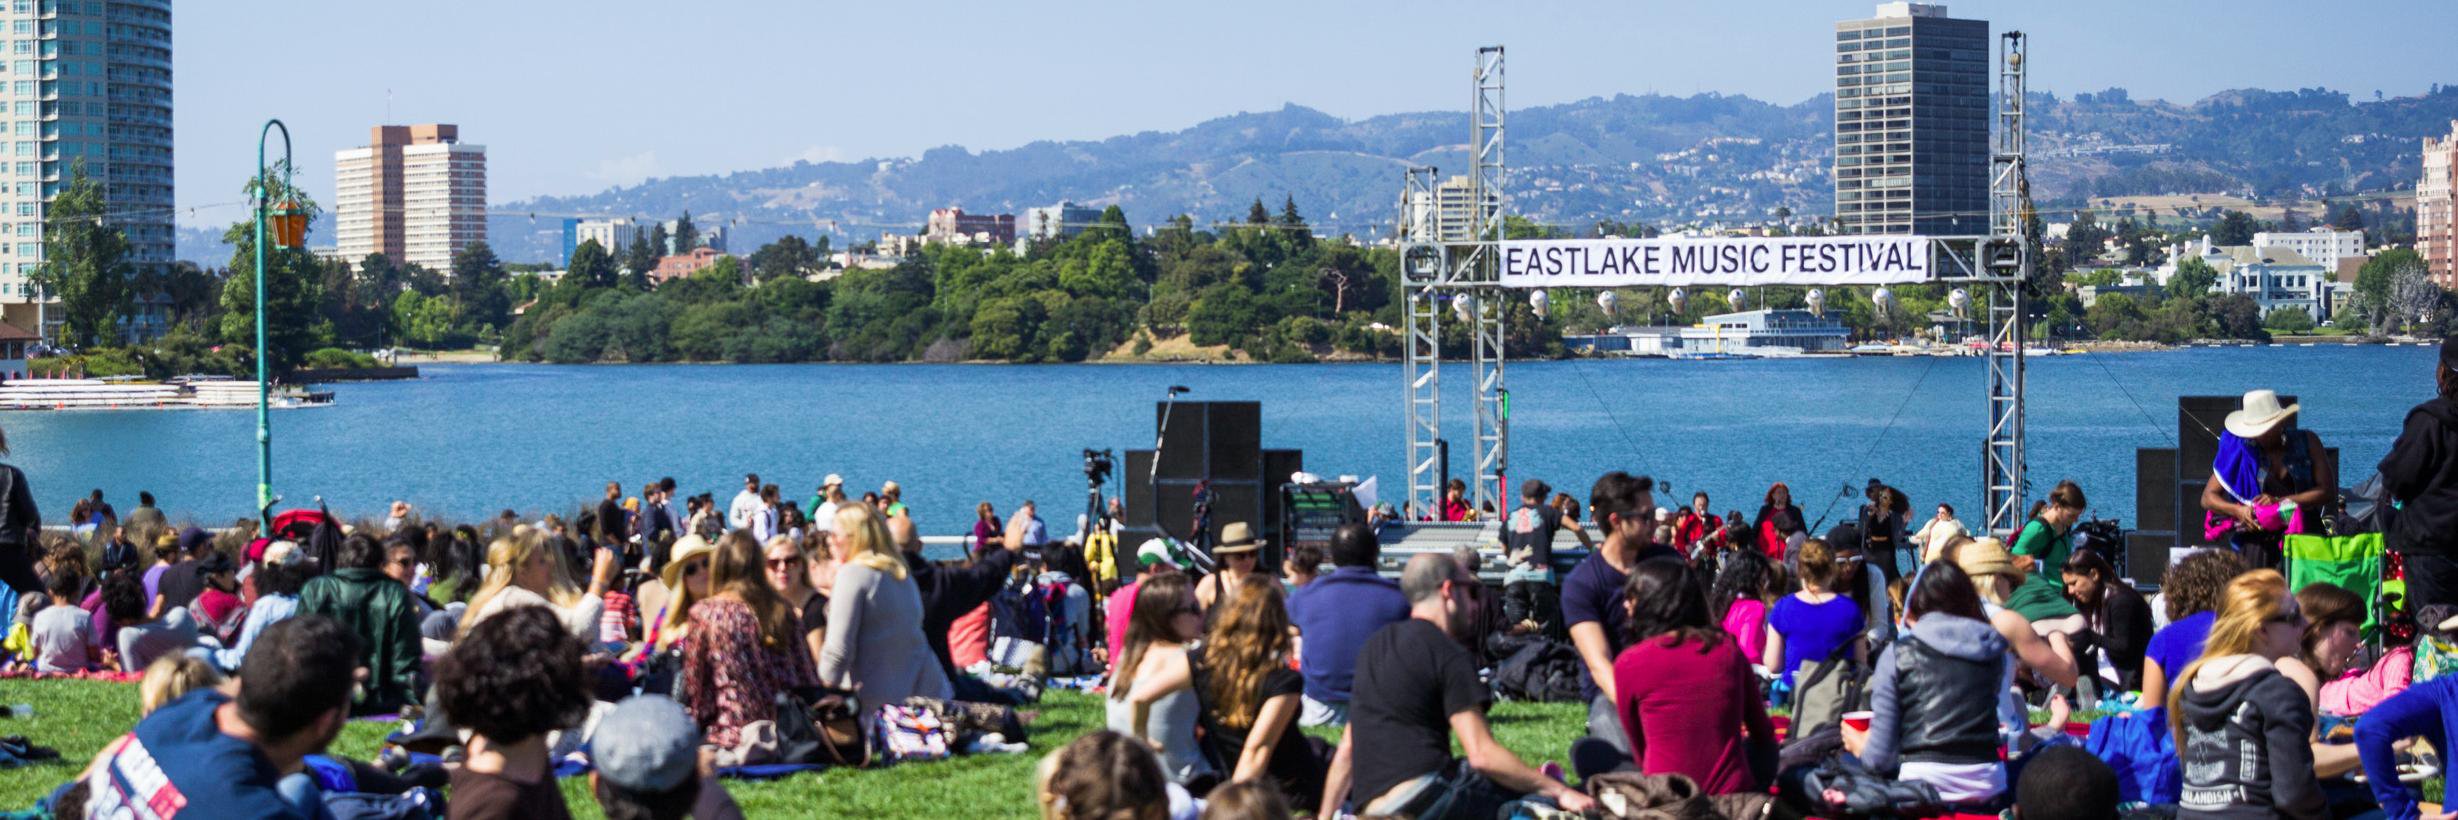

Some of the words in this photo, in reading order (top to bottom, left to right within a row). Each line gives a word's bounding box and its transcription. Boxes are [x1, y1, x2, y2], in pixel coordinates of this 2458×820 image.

[1507, 247, 1660, 275] EASTLAKE
[1672, 244, 1769, 274] MUSIC
[1781, 242, 1922, 272] FESTIVAL
